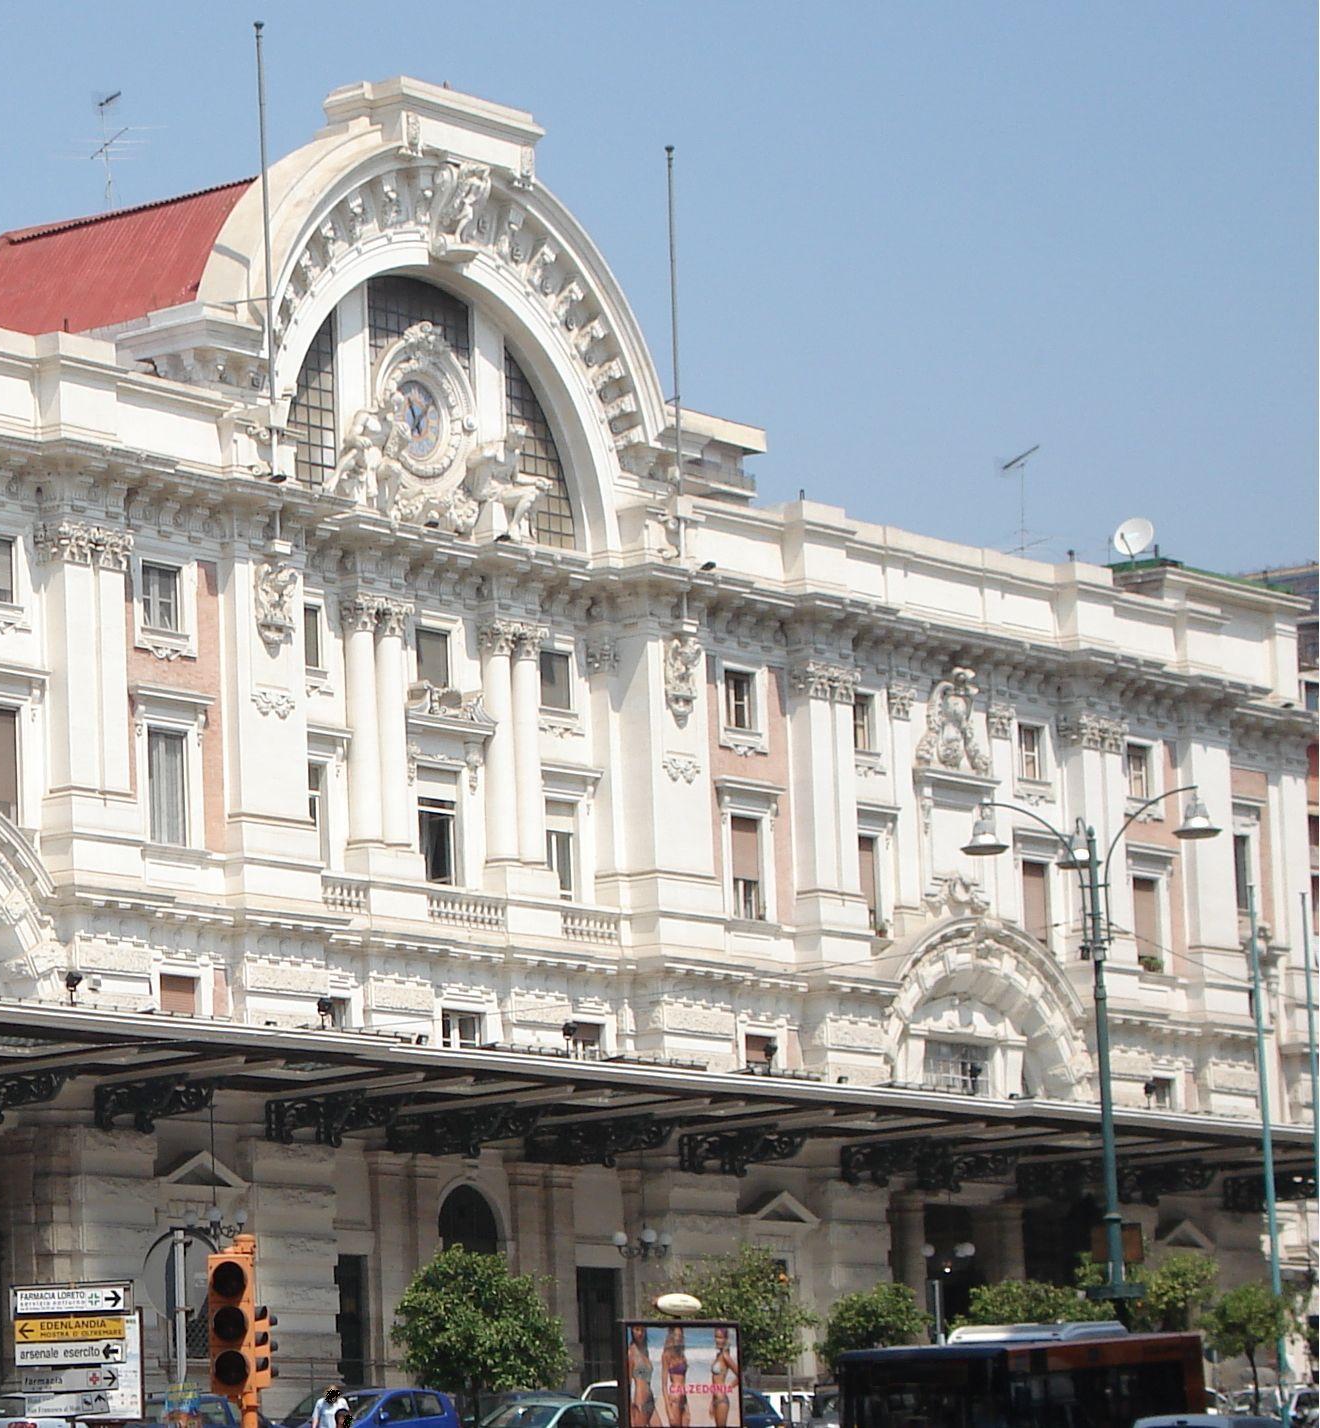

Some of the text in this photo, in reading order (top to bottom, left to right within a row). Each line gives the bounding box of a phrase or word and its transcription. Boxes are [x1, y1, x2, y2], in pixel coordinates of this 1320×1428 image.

[20, 1291, 85, 1300] FARMACIA LORETO
[40, 1320, 106, 1330] EDENLANDIA
[81, 1329, 122, 1337] OLTREMARE
[20, 1345, 100, 1360] arsenale esercito
[24, 1376, 62, 1385] farmacia
[670, 1384, 733, 1394] CALZEDONIA
